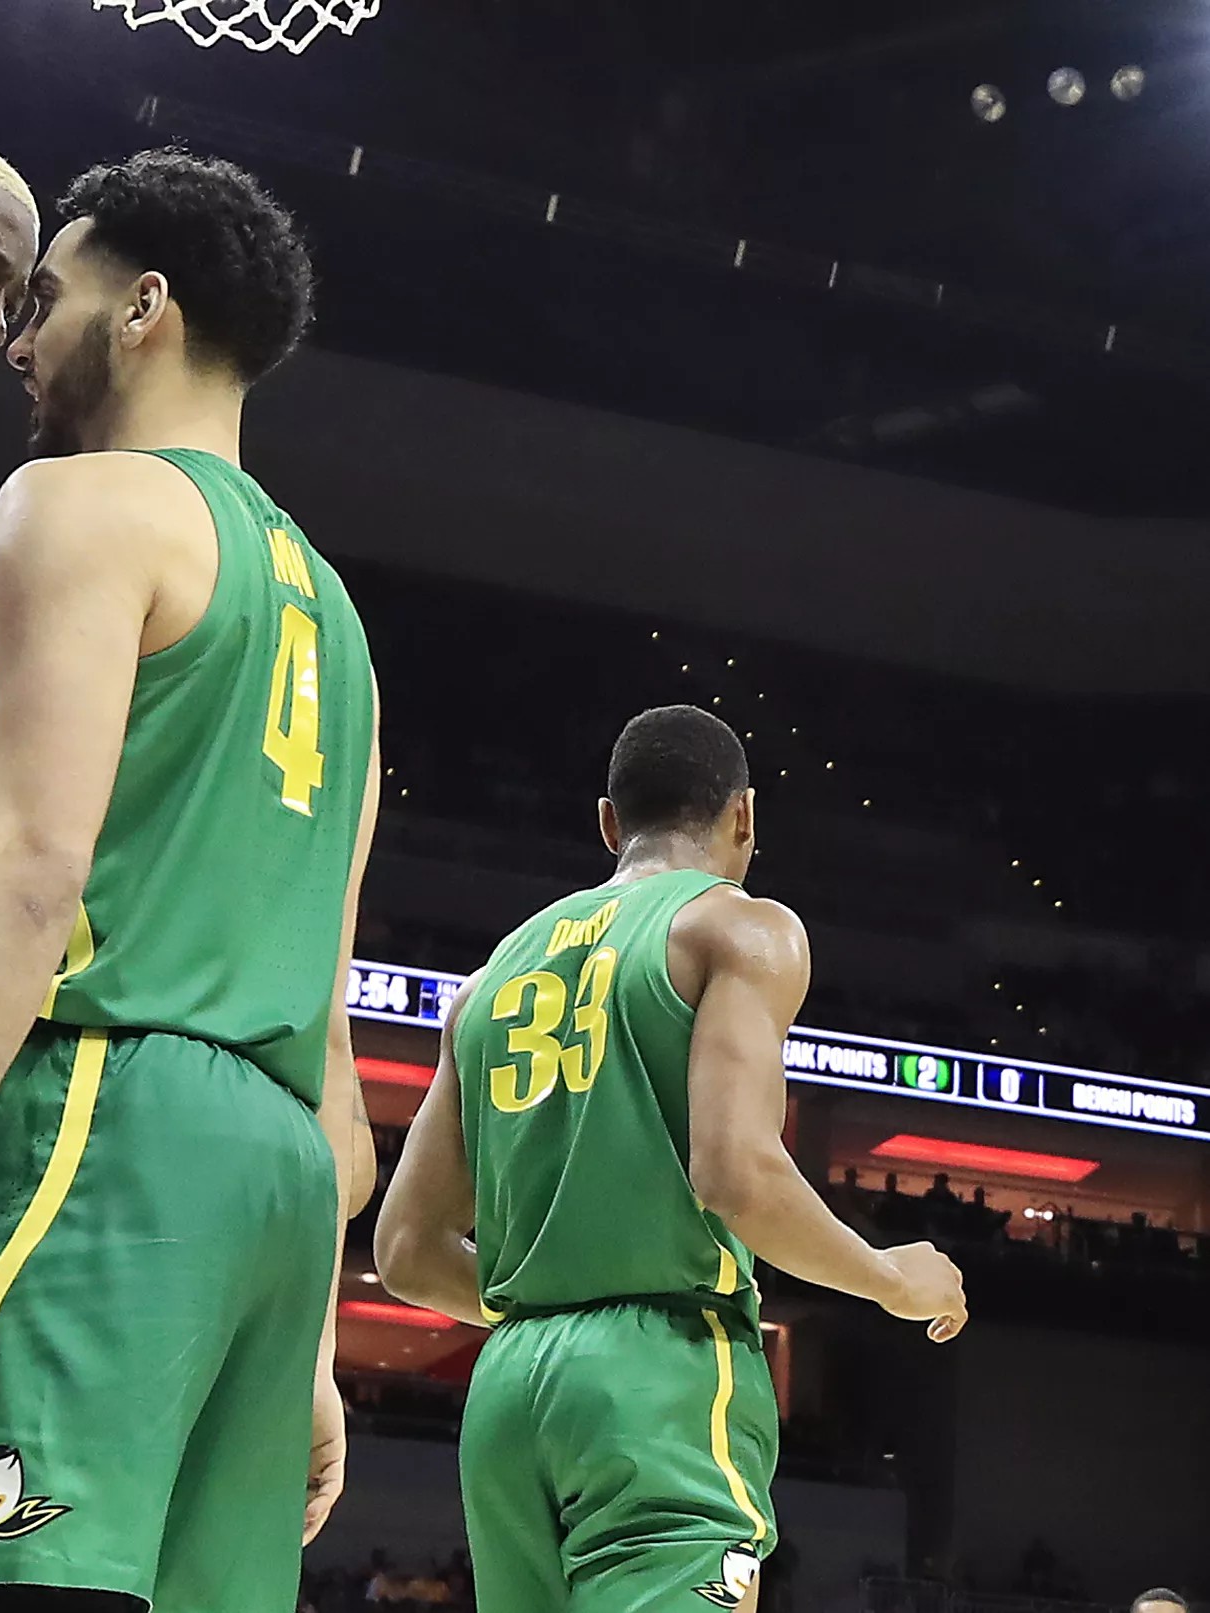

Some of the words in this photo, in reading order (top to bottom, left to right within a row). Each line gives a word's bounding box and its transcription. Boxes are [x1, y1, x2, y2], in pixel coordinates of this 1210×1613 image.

[262, 602, 324, 817] 4
[490, 946, 617, 1113] 33
[817, 1044, 887, 1079] POINTS
[917, 1056, 937, 1090] 2
[1000, 1068, 1020, 1102] 0
[1073, 1082, 1131, 1116] BENCH
[1132, 1091, 1195, 1125] POINTS
